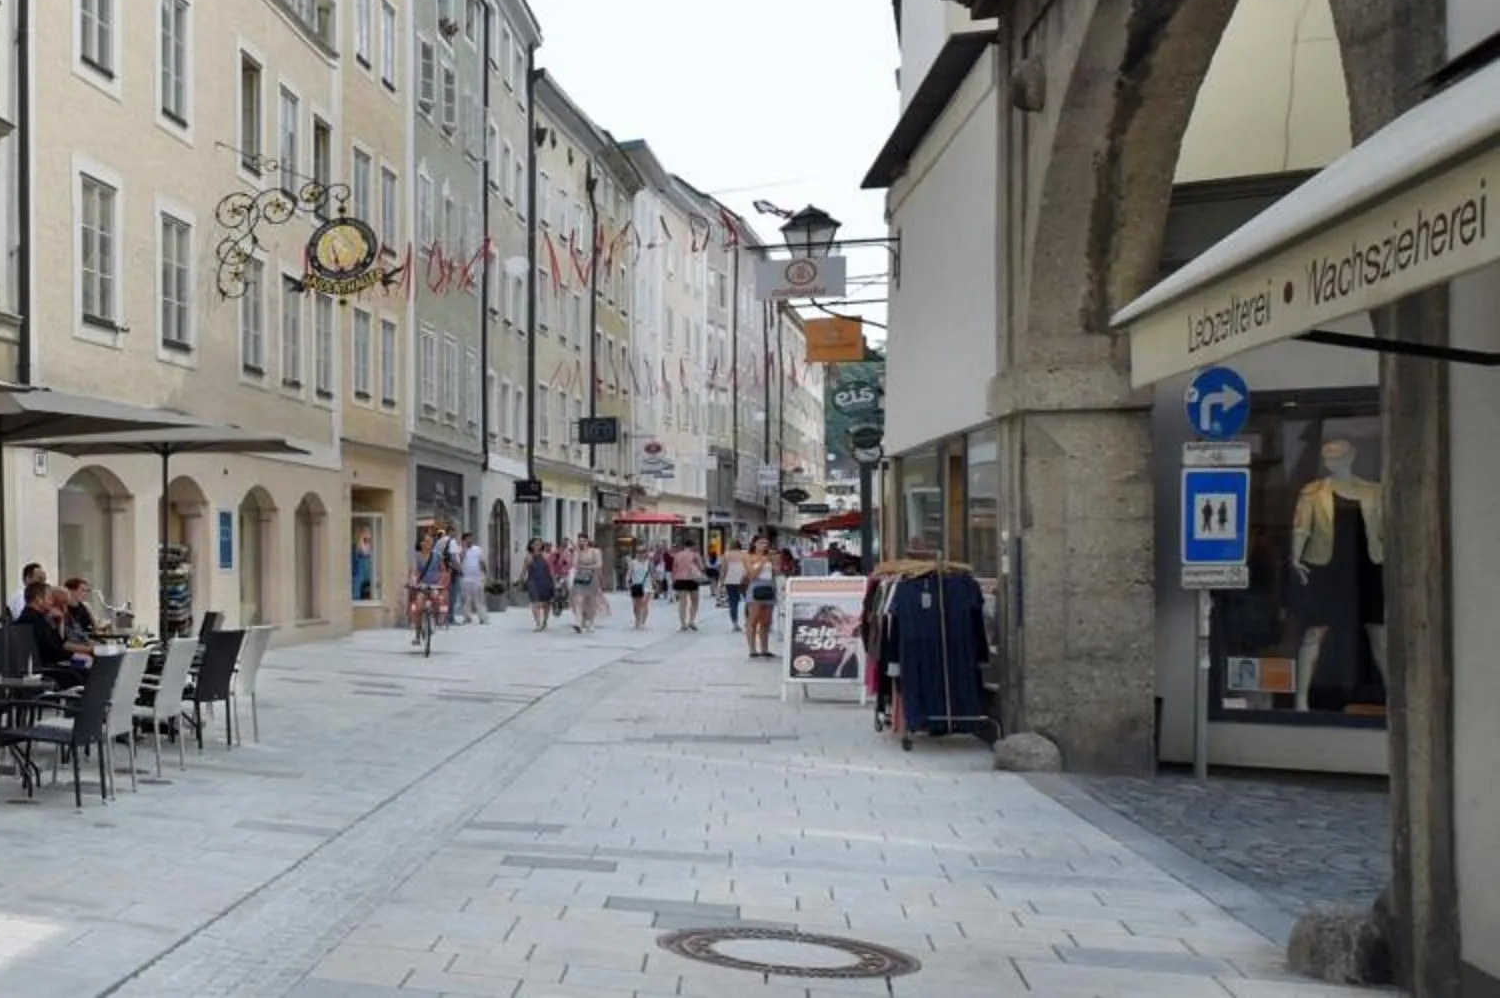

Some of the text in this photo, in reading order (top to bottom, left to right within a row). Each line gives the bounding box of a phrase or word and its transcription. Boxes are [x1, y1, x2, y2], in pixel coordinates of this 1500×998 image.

[1187, 178, 1487, 354] Lebzelterei Wachszieherei
[834, 382, 876, 404] eis
